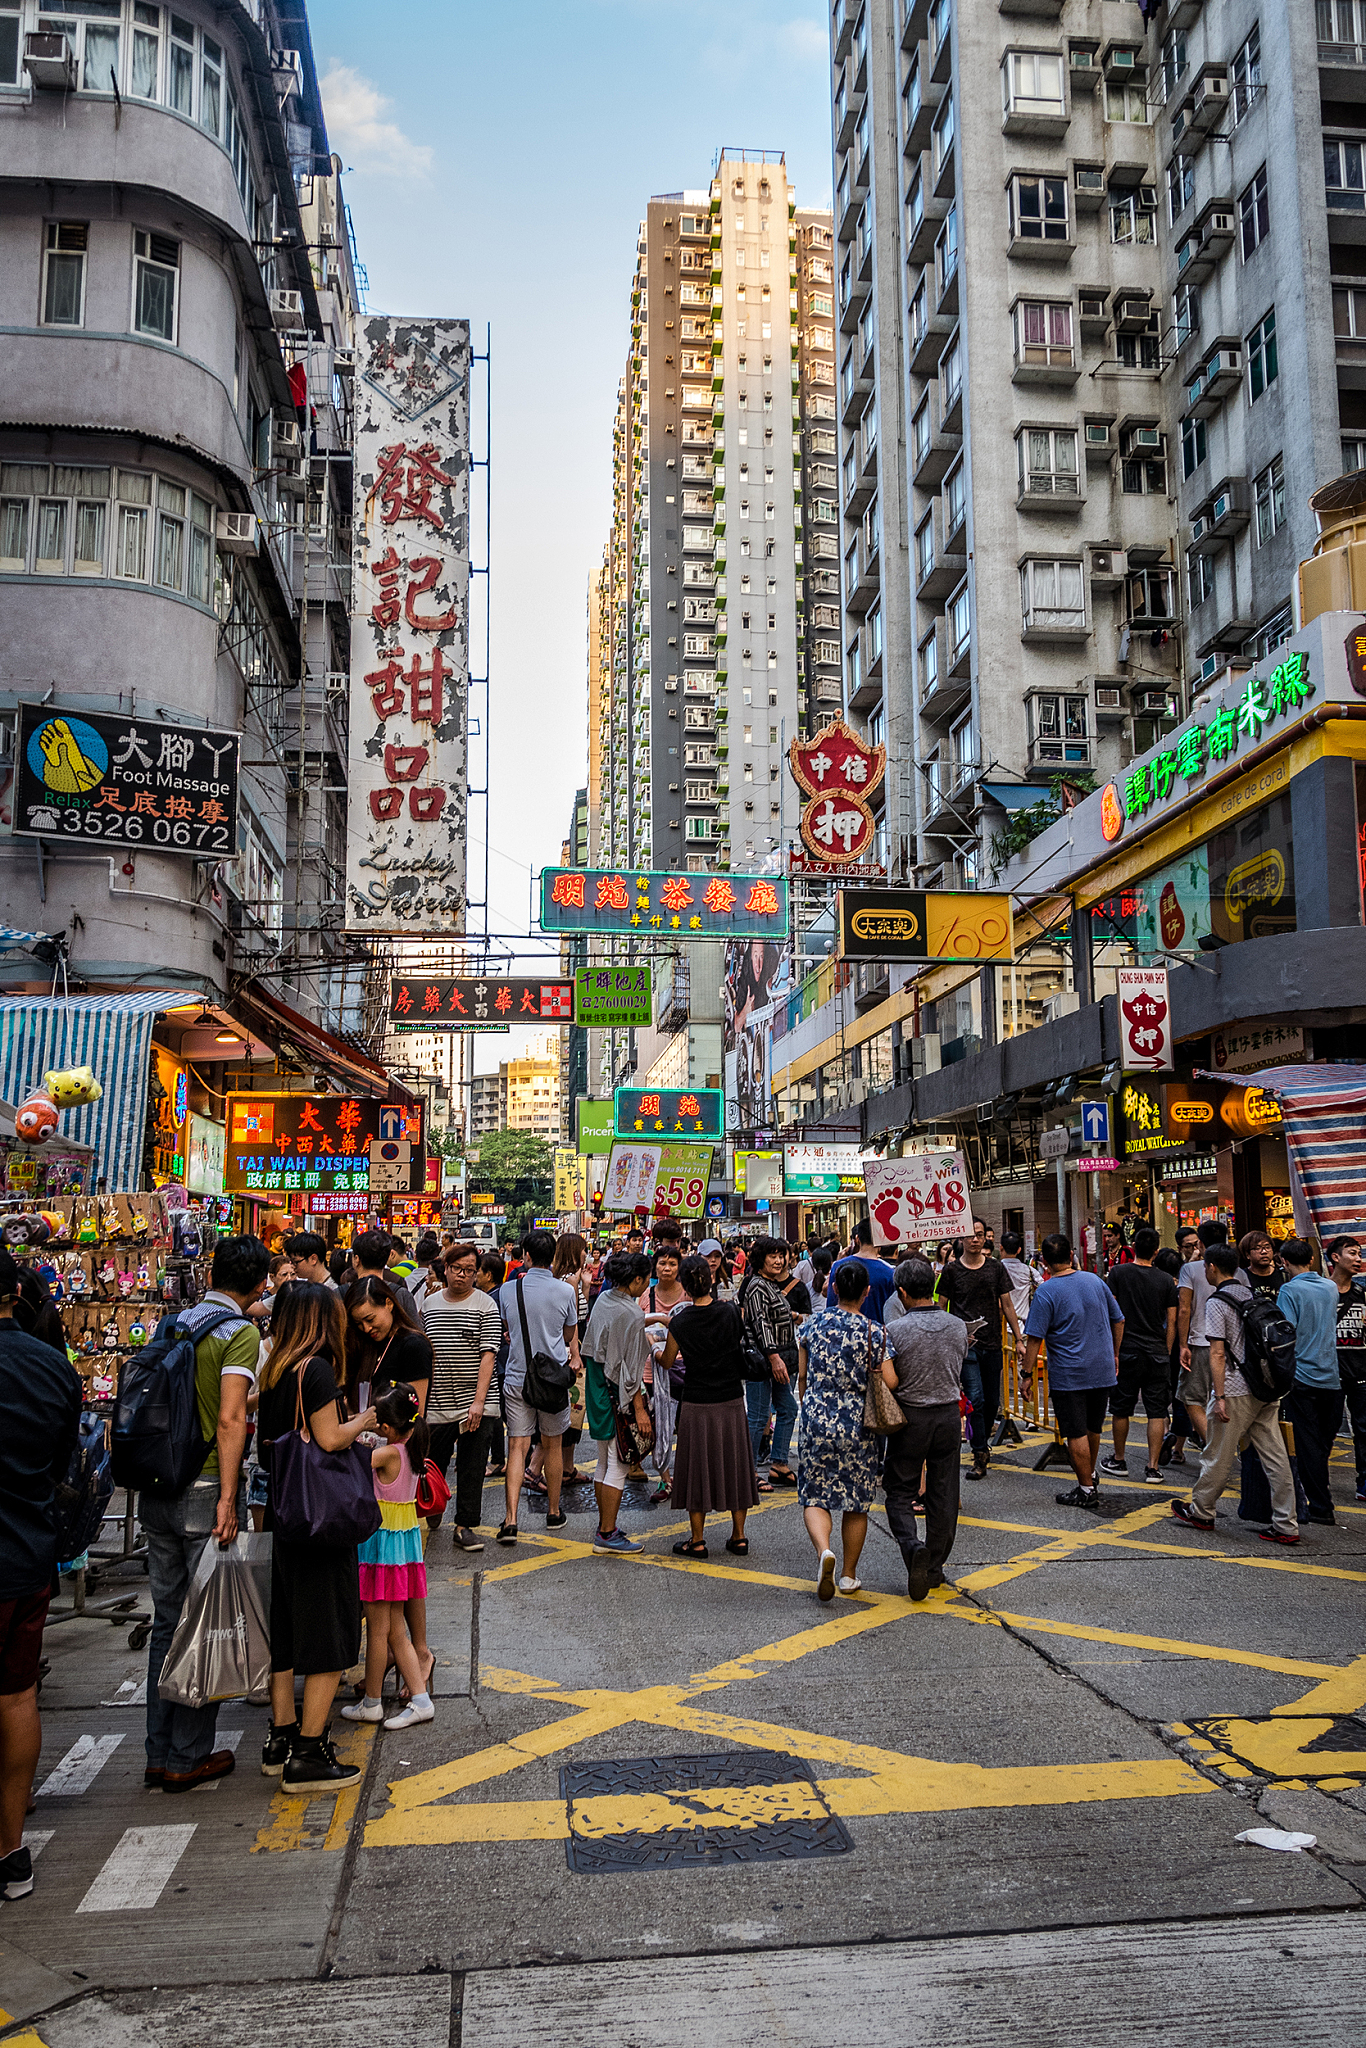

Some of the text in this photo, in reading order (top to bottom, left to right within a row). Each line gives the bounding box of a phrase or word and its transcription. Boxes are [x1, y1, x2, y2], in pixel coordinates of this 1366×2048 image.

[364, 442, 457, 823] 發記甜品
[1124, 652, 1310, 820] 譚仔雲南米線
[112, 727, 233, 779] 大腳丫
[809, 752, 868, 783] 中信
[113, 766, 230, 798] Foot Massage
[1220, 761, 1286, 814] cafe de coral
[44, 791, 91, 810] Relax
[93, 786, 229, 825] 足底按摩
[63, 808, 229, 850] 3526 0672
[813, 800, 864, 852] 押
[552, 873, 629, 909] 明苑
[660, 877, 779, 914] 茶餐廳
[1162, 893, 1180, 940] 譚仔
[593, 996, 647, 1008] 27600029
[1132, 1003, 1157, 1017] 中信
[1134, 1026, 1158, 1050] 押
[298, 1100, 362, 1133] 大華
[638, 1094, 700, 1117] 明苑
[634, 1119, 704, 1132] 雲吞大王
[801, 1146, 824, 1157] 大通
[1125, 1138, 1146, 1154] ROYAL
[236, 1156, 264, 1170] TAI
[270, 1156, 307, 1171] WAH
[396, 1164, 402, 1175] 7
[935, 1166, 960, 1180] WiFi
[246, 1171, 321, 1190] 政府註冊
[396, 1180, 408, 1190] 12
[654, 1177, 705, 1208] $58
[905, 1180, 966, 1219] $48
[906, 1226, 966, 1240] Tel: 2755 8541
[930, 1219, 959, 1227] Massage
